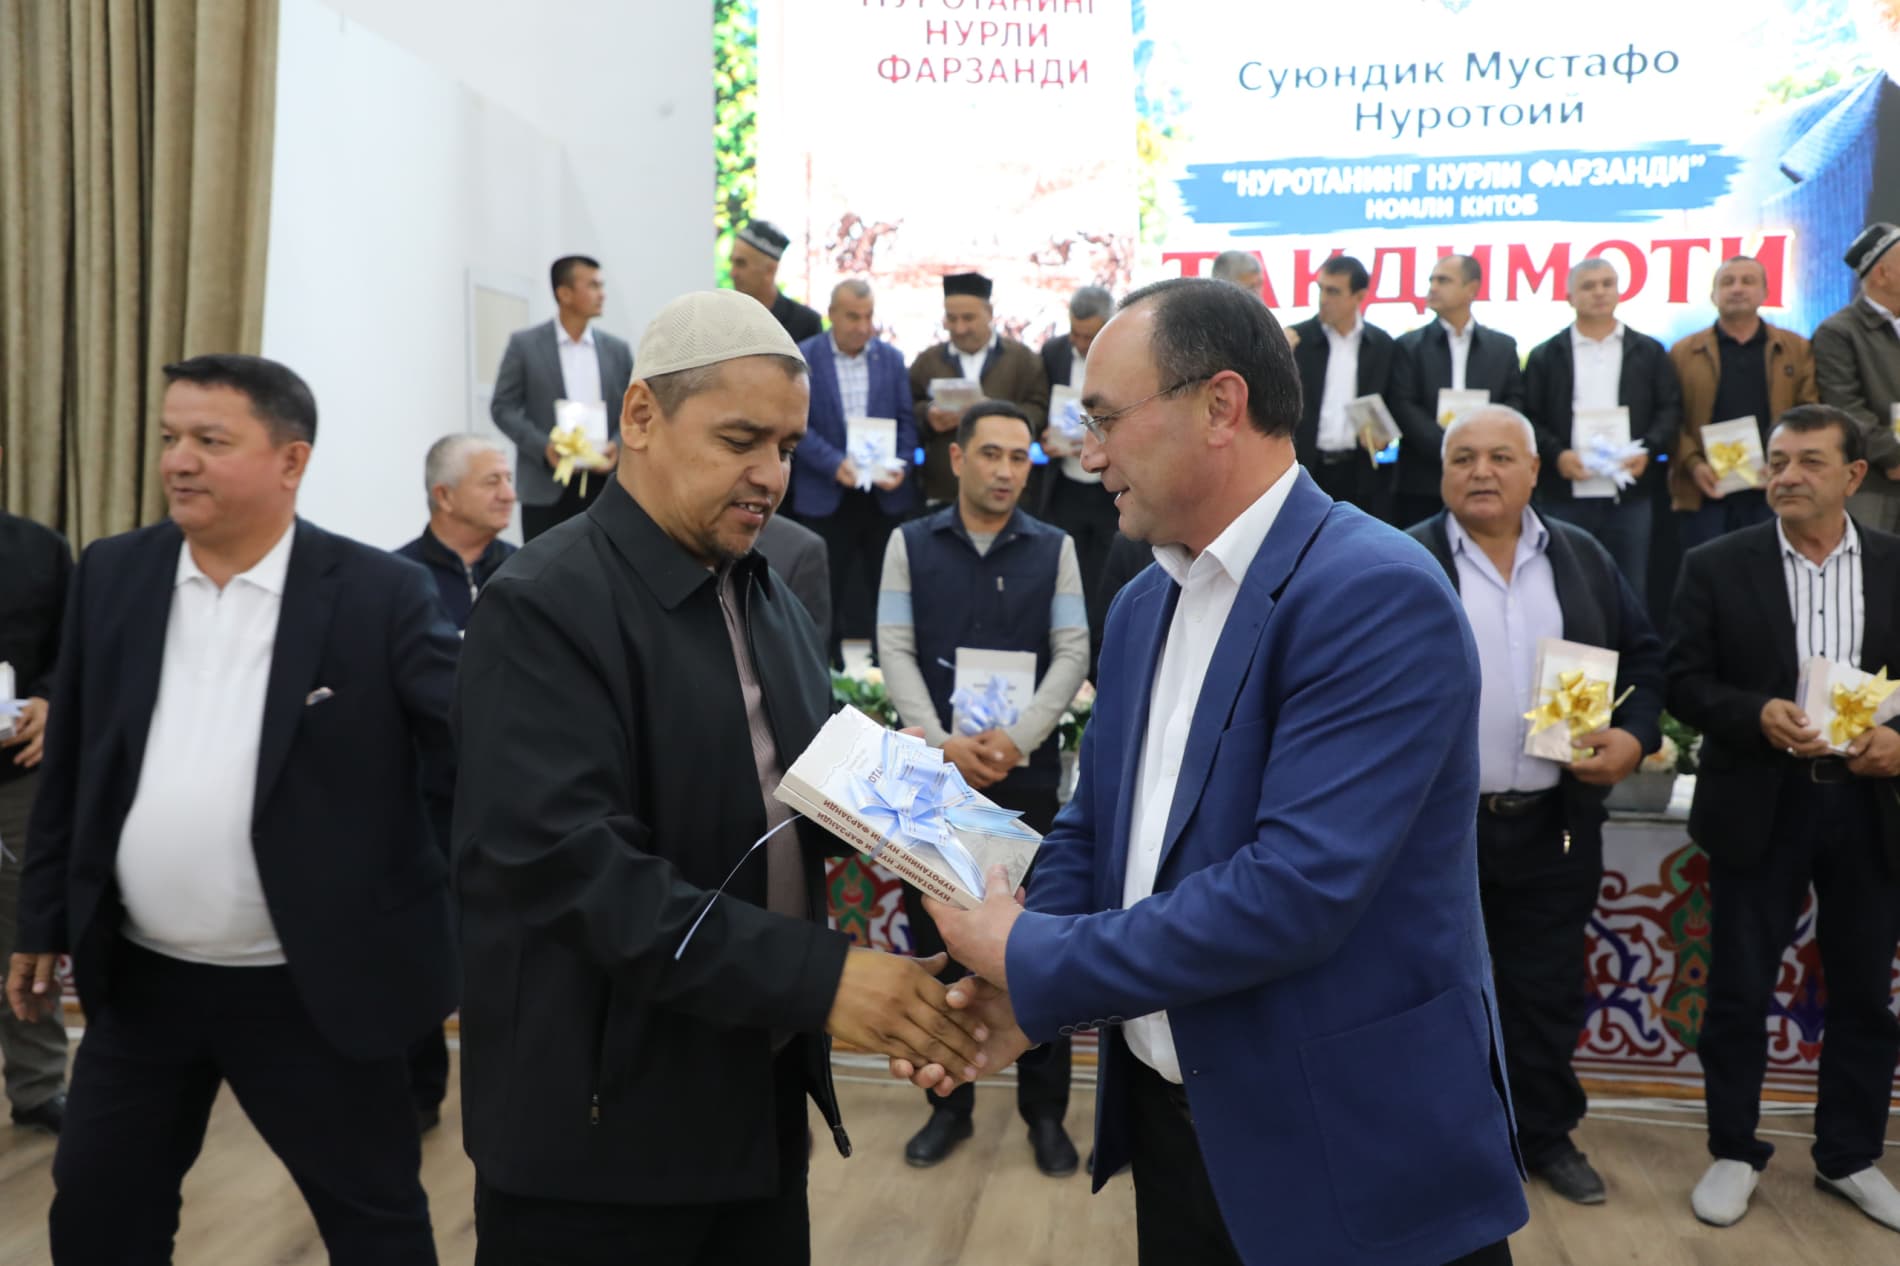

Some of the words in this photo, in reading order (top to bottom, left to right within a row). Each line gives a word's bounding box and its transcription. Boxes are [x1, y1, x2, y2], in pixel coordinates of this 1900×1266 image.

[926, 19, 1048, 47] НУРЛИ
[877, 54, 1088, 89] ФАРЗАНДИ
[1238, 61, 1445, 99] Суюндик
[1466, 43, 1679, 89] Мустафо
[1356, 92, 1584, 139] Нуротоий
[1426, 161, 1522, 191] НУРЛИ
[1365, 196, 1454, 220] НОМЛИ
[1460, 193, 1539, 218] КИТОБ
[823, 800, 870, 833] ФАРЗАНДИ
[895, 863, 951, 903] НУРОТАНИНГ
[901, 853, 956, 893] НУРОТАНИНГ
